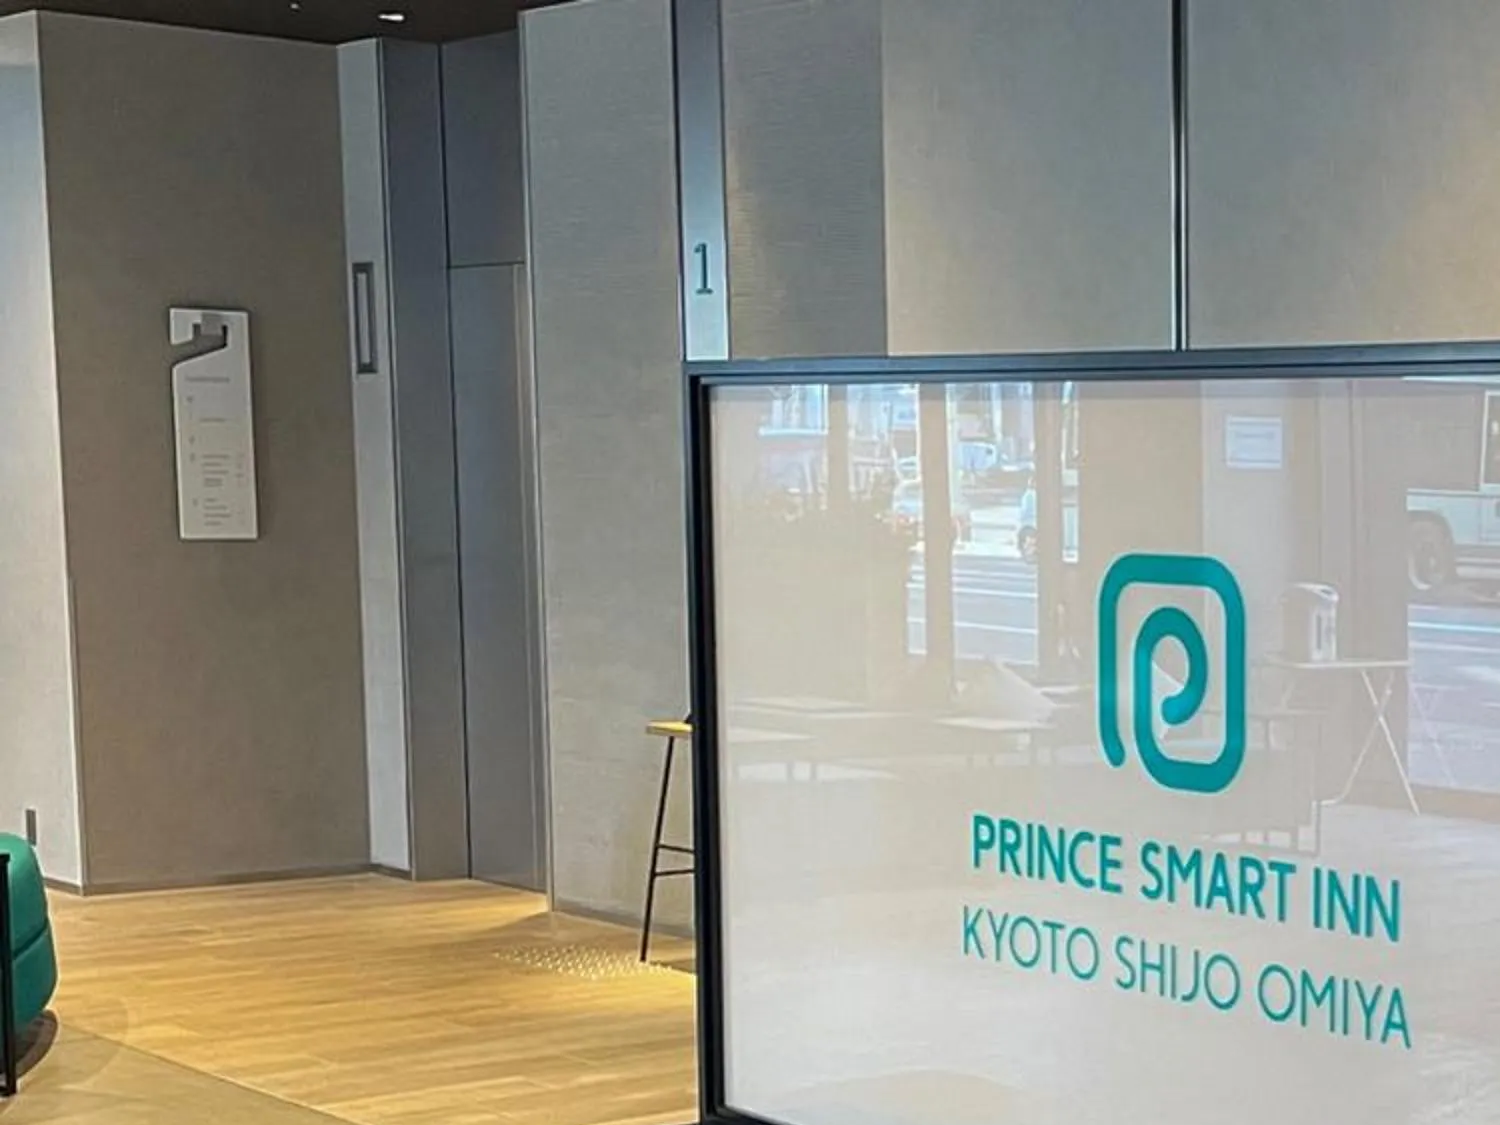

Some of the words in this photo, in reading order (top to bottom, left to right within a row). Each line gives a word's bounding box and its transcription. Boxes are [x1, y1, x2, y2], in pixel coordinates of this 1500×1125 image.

[693, 242, 715, 296] 1
[972, 814, 1123, 894] PRINCE
[1140, 840, 1297, 923] SMART
[1312, 866, 1400, 943] INN
[962, 904, 1100, 981] KYOTO
[1114, 935, 1242, 1010] SHIJO
[1257, 963, 1412, 1049] OMIYA
